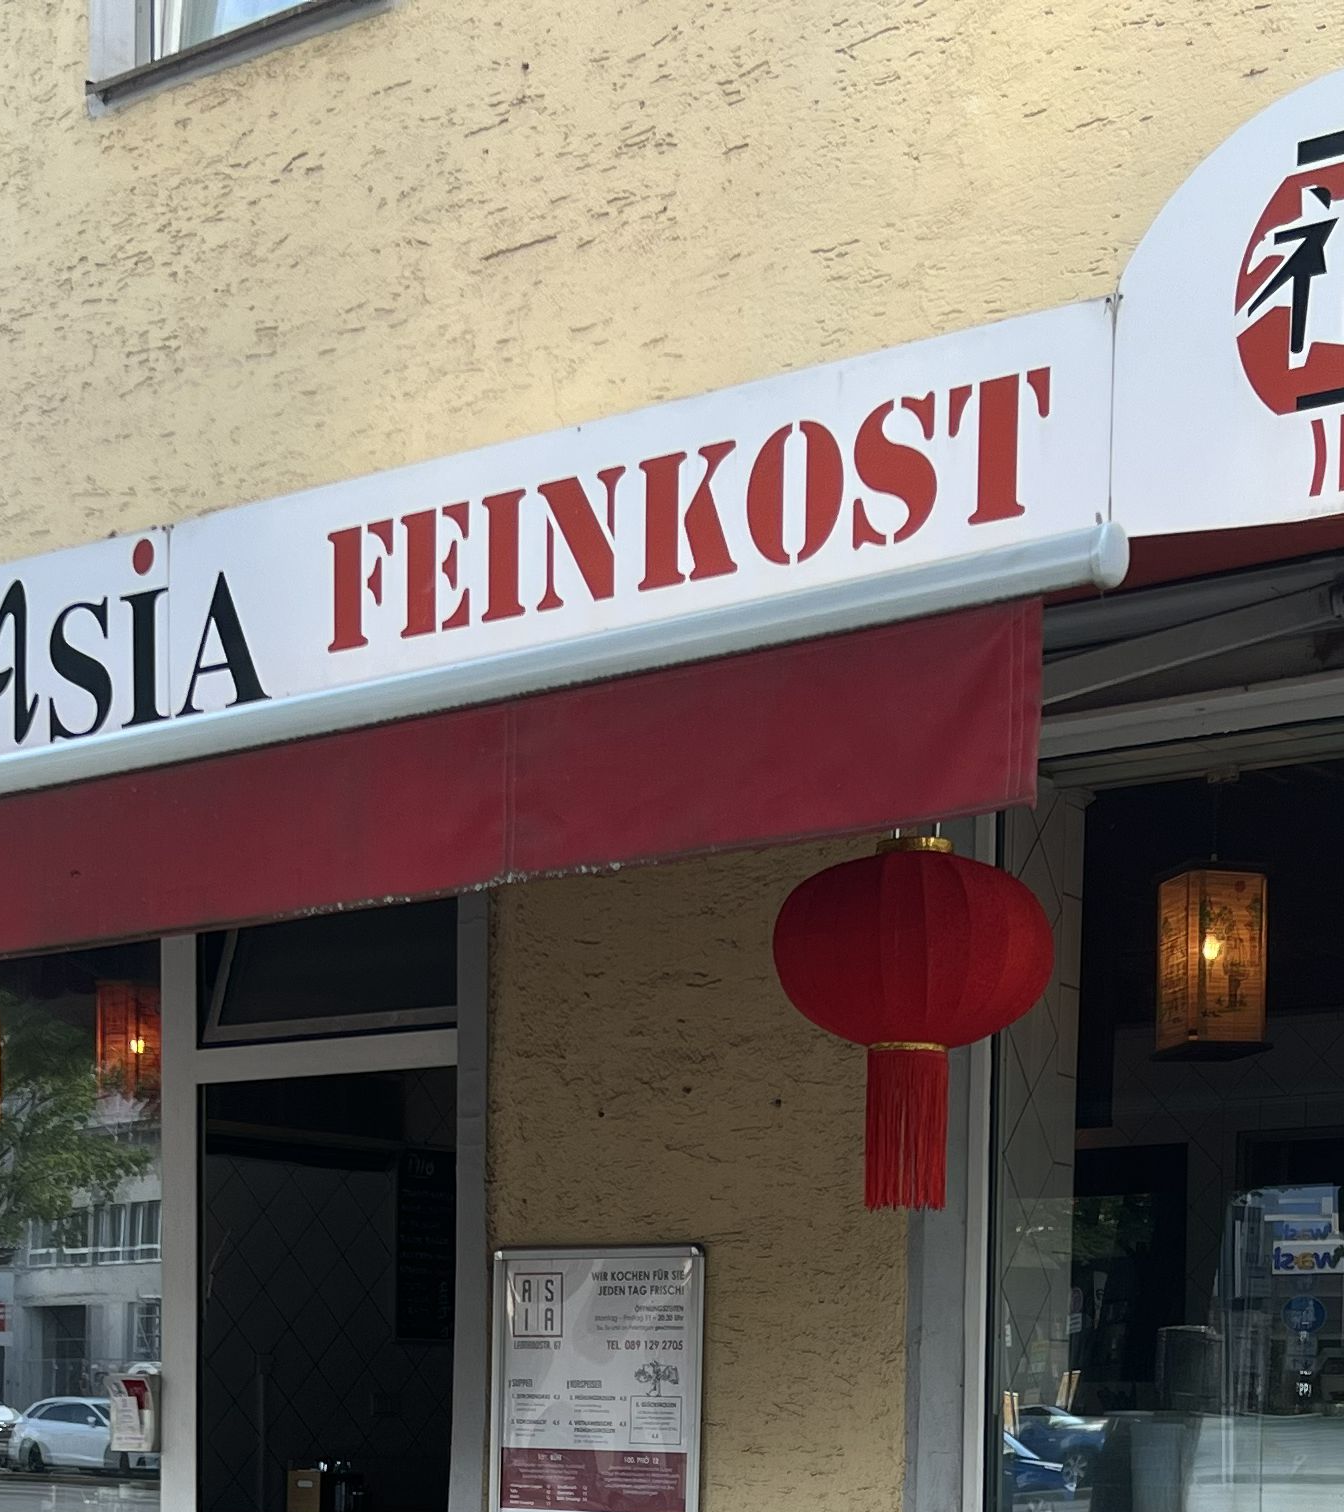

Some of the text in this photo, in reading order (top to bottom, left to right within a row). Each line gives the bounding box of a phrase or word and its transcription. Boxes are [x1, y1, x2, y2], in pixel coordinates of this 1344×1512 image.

[325, 365, 1051, 653] FEINKOST
[592, 1271, 608, 1281] WIR
[610, 1270, 650, 1281] KOCHEN
[652, 1268, 669, 1280] FÜR
[598, 1285, 685, 1297] JEDEN TAG FRISCH!
[624, 1340, 641, 1350] 089
[644, 1340, 660, 1350] 129
[662, 1340, 684, 1350] 2705
